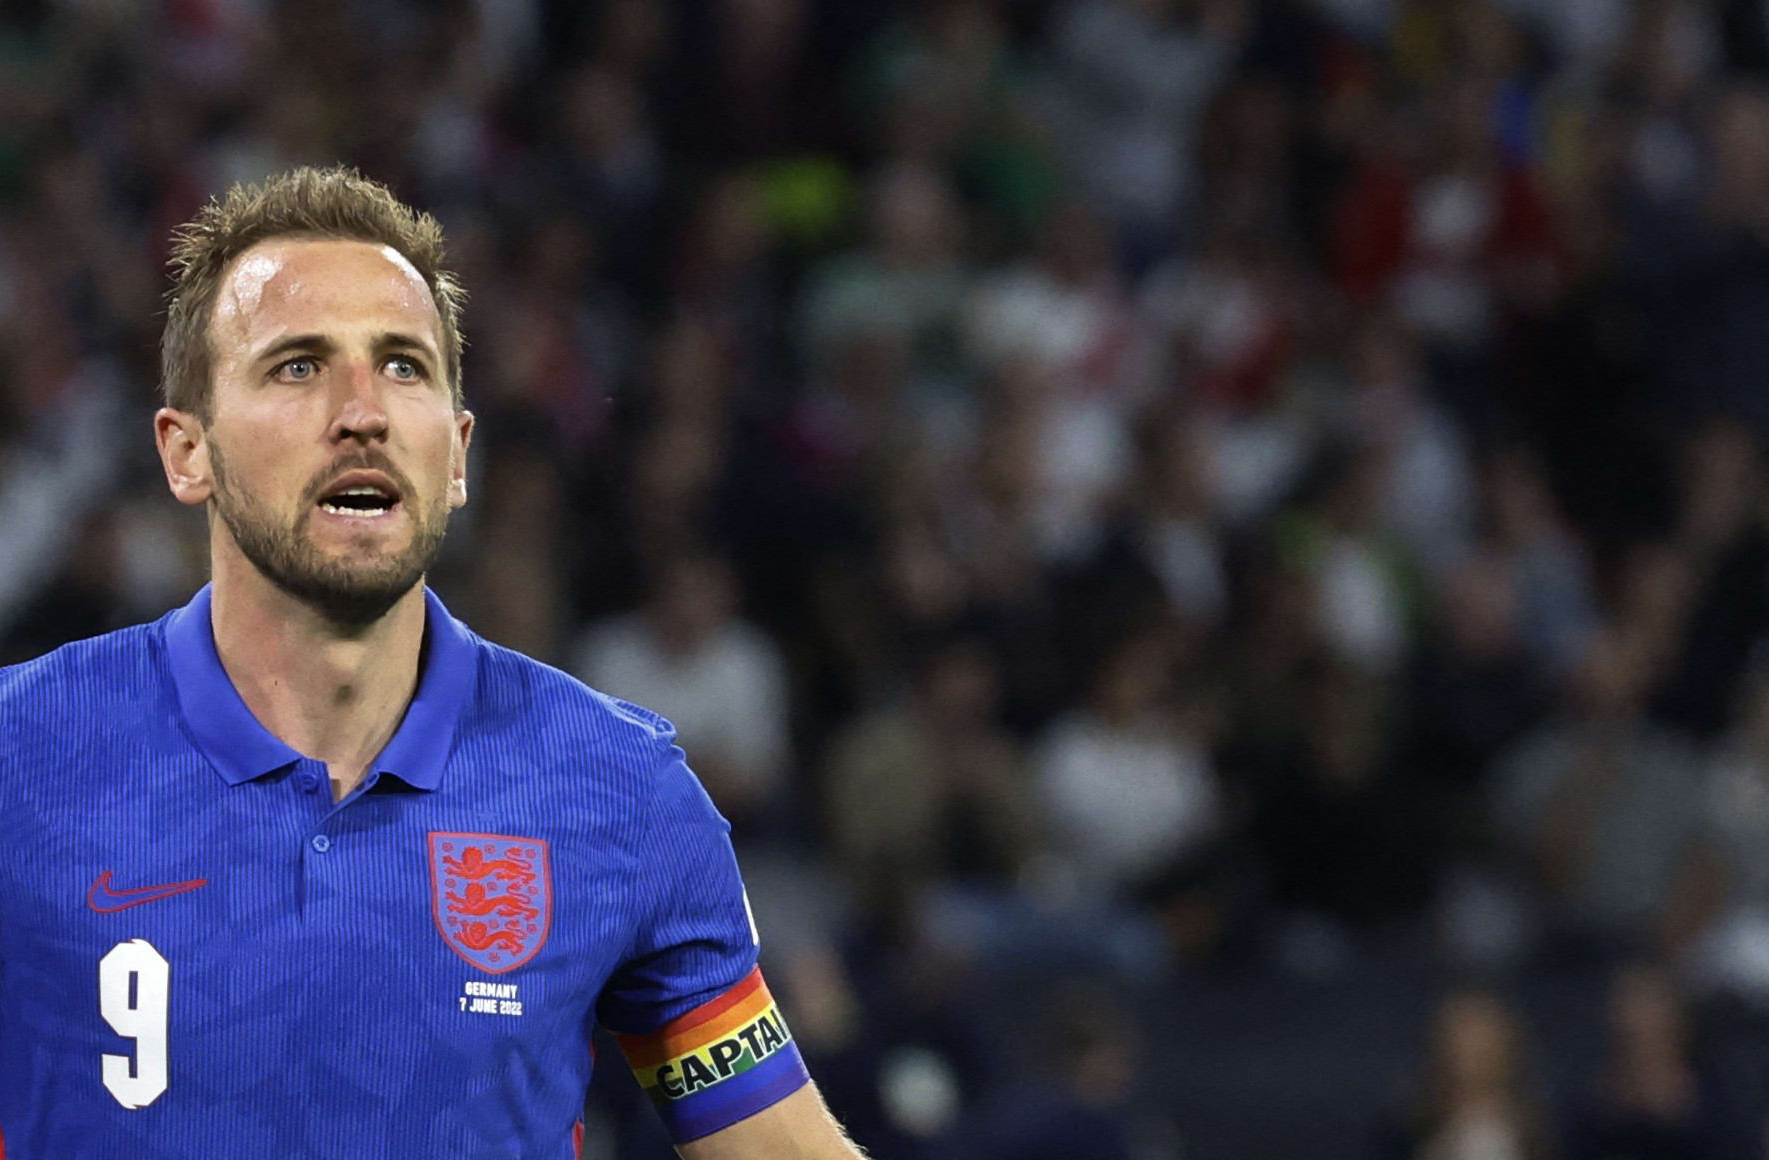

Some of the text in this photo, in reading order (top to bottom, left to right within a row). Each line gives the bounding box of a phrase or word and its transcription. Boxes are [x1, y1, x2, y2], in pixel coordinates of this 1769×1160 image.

[465, 981, 518, 999] GERMANY
[459, 997, 522, 1016] 7 JUNE 2022
[99, 938, 169, 1110] 9
